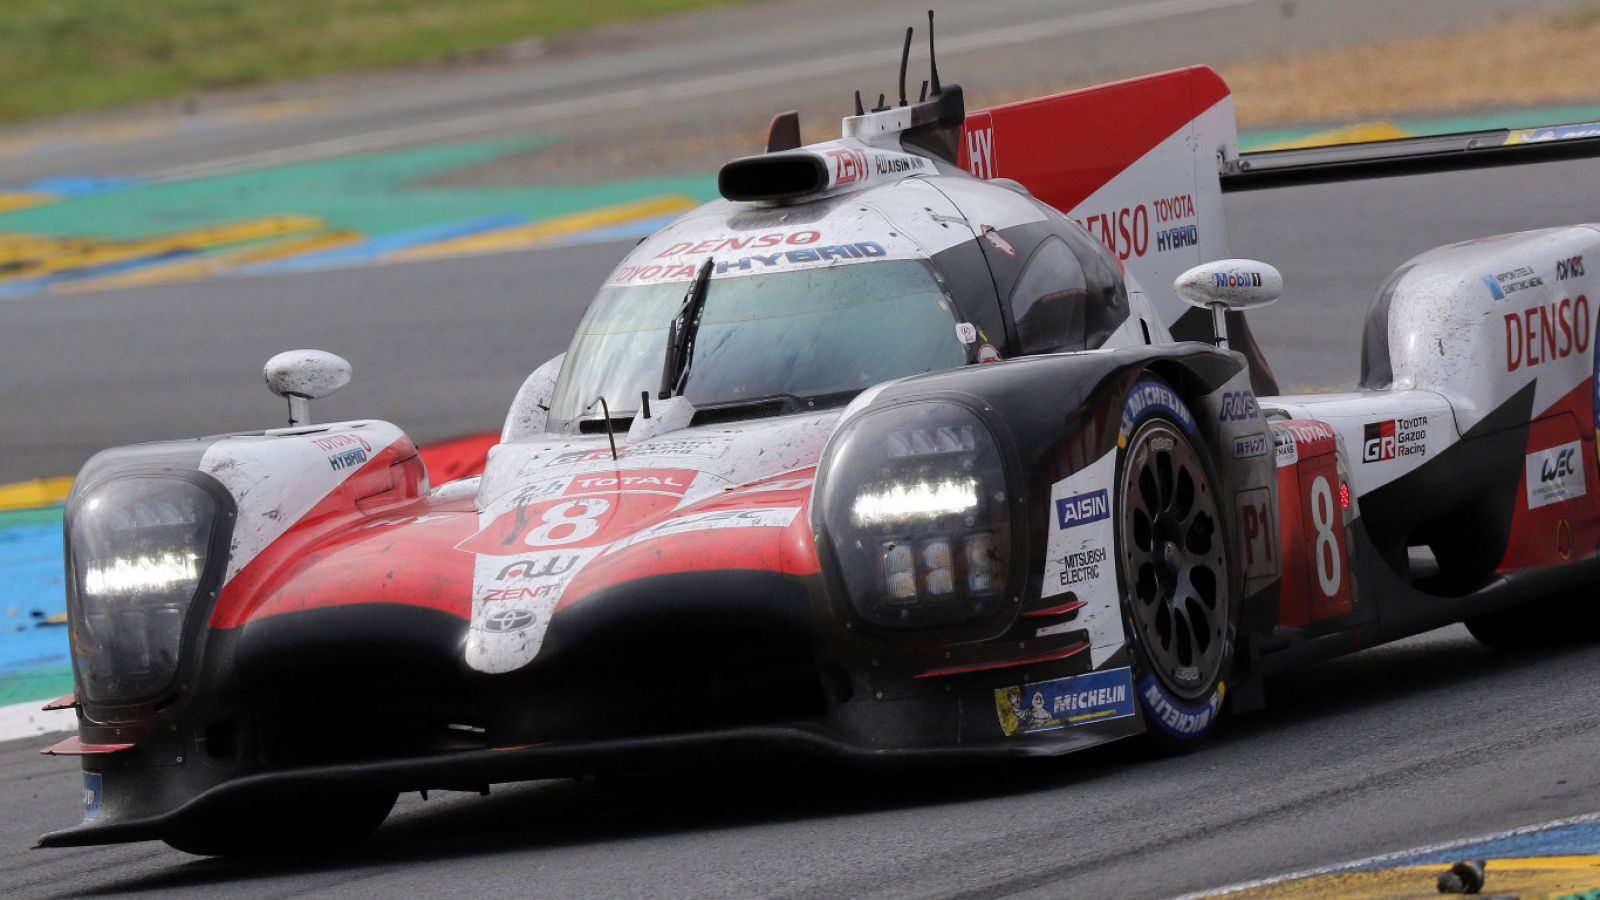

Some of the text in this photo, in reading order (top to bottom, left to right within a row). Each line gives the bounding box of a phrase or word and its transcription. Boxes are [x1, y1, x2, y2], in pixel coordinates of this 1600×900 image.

[825, 148, 869, 184] ZENT
[1153, 194, 1195, 222] TOYOTA
[654, 230, 821, 259] DENSO
[1156, 225, 1198, 252] HYBRID
[615, 241, 888, 283] TOYOTA HYBRID
[1216, 272, 1250, 288] Mobil
[1504, 294, 1590, 372] DENSO
[1128, 386, 1190, 425] MICHELIN
[1288, 423, 1335, 444] TOTAL
[1397, 416, 1428, 430] TOYOTA
[1398, 430, 1426, 443] GAZOO
[328, 447, 367, 471] HYBRID
[1364, 436, 1395, 461] GR
[1398, 442, 1426, 456] Racing
[1541, 448, 1575, 483] WEC
[576, 476, 683, 488] TOTAL
[524, 498, 610, 547] 8
[1064, 495, 1107, 523] AISIN
[1242, 503, 1272, 565] P1
[1311, 475, 1341, 597] 8
[1064, 547, 1106, 569] MITSUBISHI
[1060, 564, 1099, 586] ELECTRIC
[483, 584, 561, 602] ZENT
[1053, 684, 1126, 714] MICHELIN
[1145, 684, 1210, 733] MICHELIN
